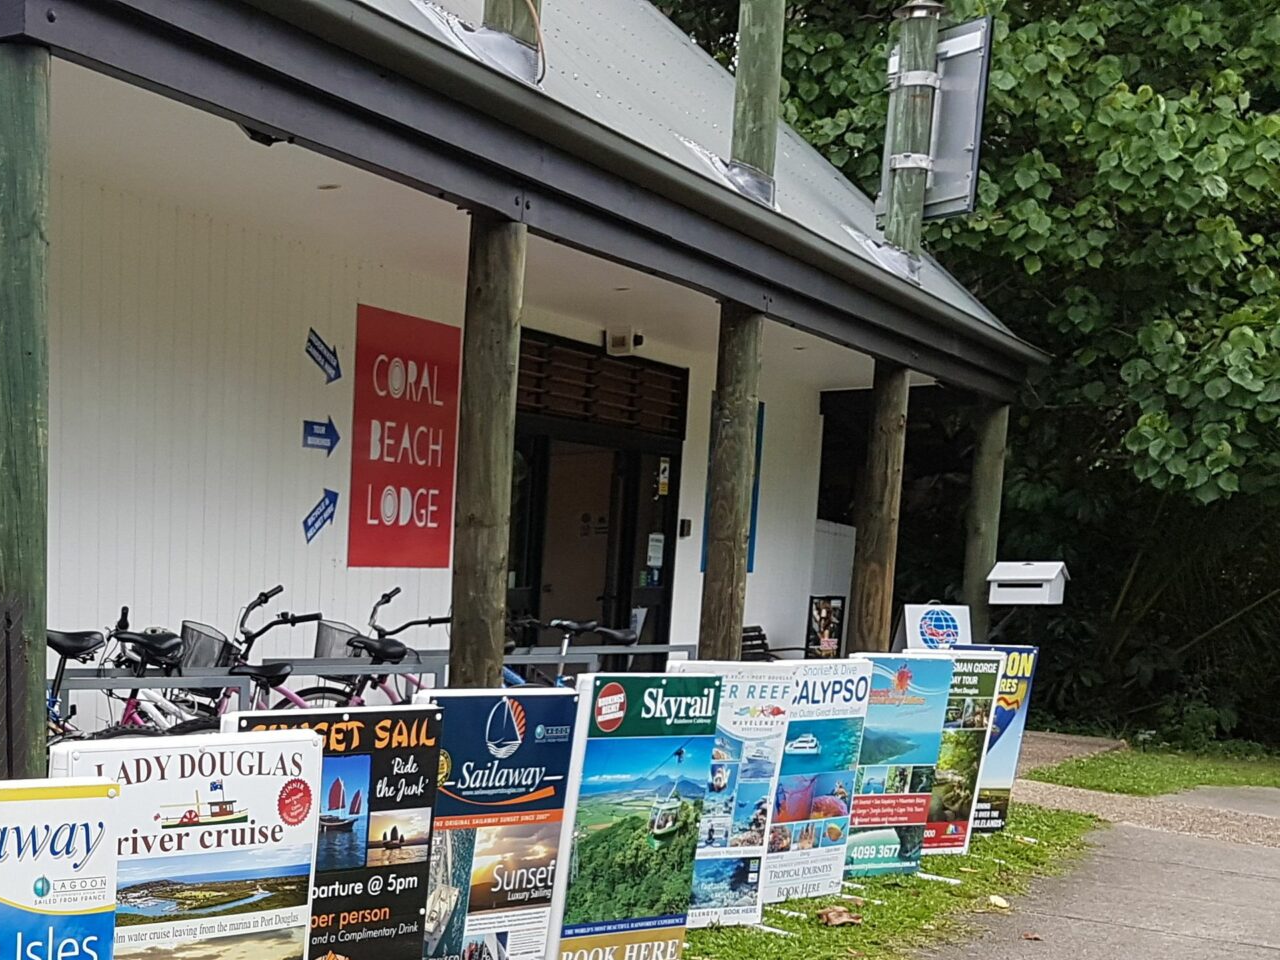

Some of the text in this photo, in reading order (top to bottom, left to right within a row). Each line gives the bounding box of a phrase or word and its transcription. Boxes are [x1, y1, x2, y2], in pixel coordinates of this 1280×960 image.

[373, 354, 443, 406] CORAL
[369, 419, 443, 467] BEACH
[367, 484, 439, 527] LODGE
[841, 665, 857, 675] Dive
[974, 663, 997, 673] GORGE
[747, 685, 790, 699] REEF
[792, 676, 868, 705] ALYPSO
[962, 676, 978, 685] TOUR
[641, 688, 714, 725] Skyrail
[375, 719, 435, 748] SAIL
[179, 751, 304, 779] DOUGLAS
[457, 760, 546, 792] Sailaway
[376, 782, 394, 798] the
[117, 820, 284, 856] river cruise
[851, 846, 876, 859] 4099
[878, 844, 900, 857] 3677
[53, 879, 106, 890] LAGOON
[368, 874, 418, 895] @ 5pm
[491, 860, 556, 892] Sunset
[508, 888, 551, 901] Luxury Sailing
[777, 883, 821, 897] BOOK HERE
[128, 912, 298, 941] water cruise leaving from the marina in Port Douglas
[340, 907, 390, 929] person
[312, 921, 418, 945] and a Complimentary Drink
